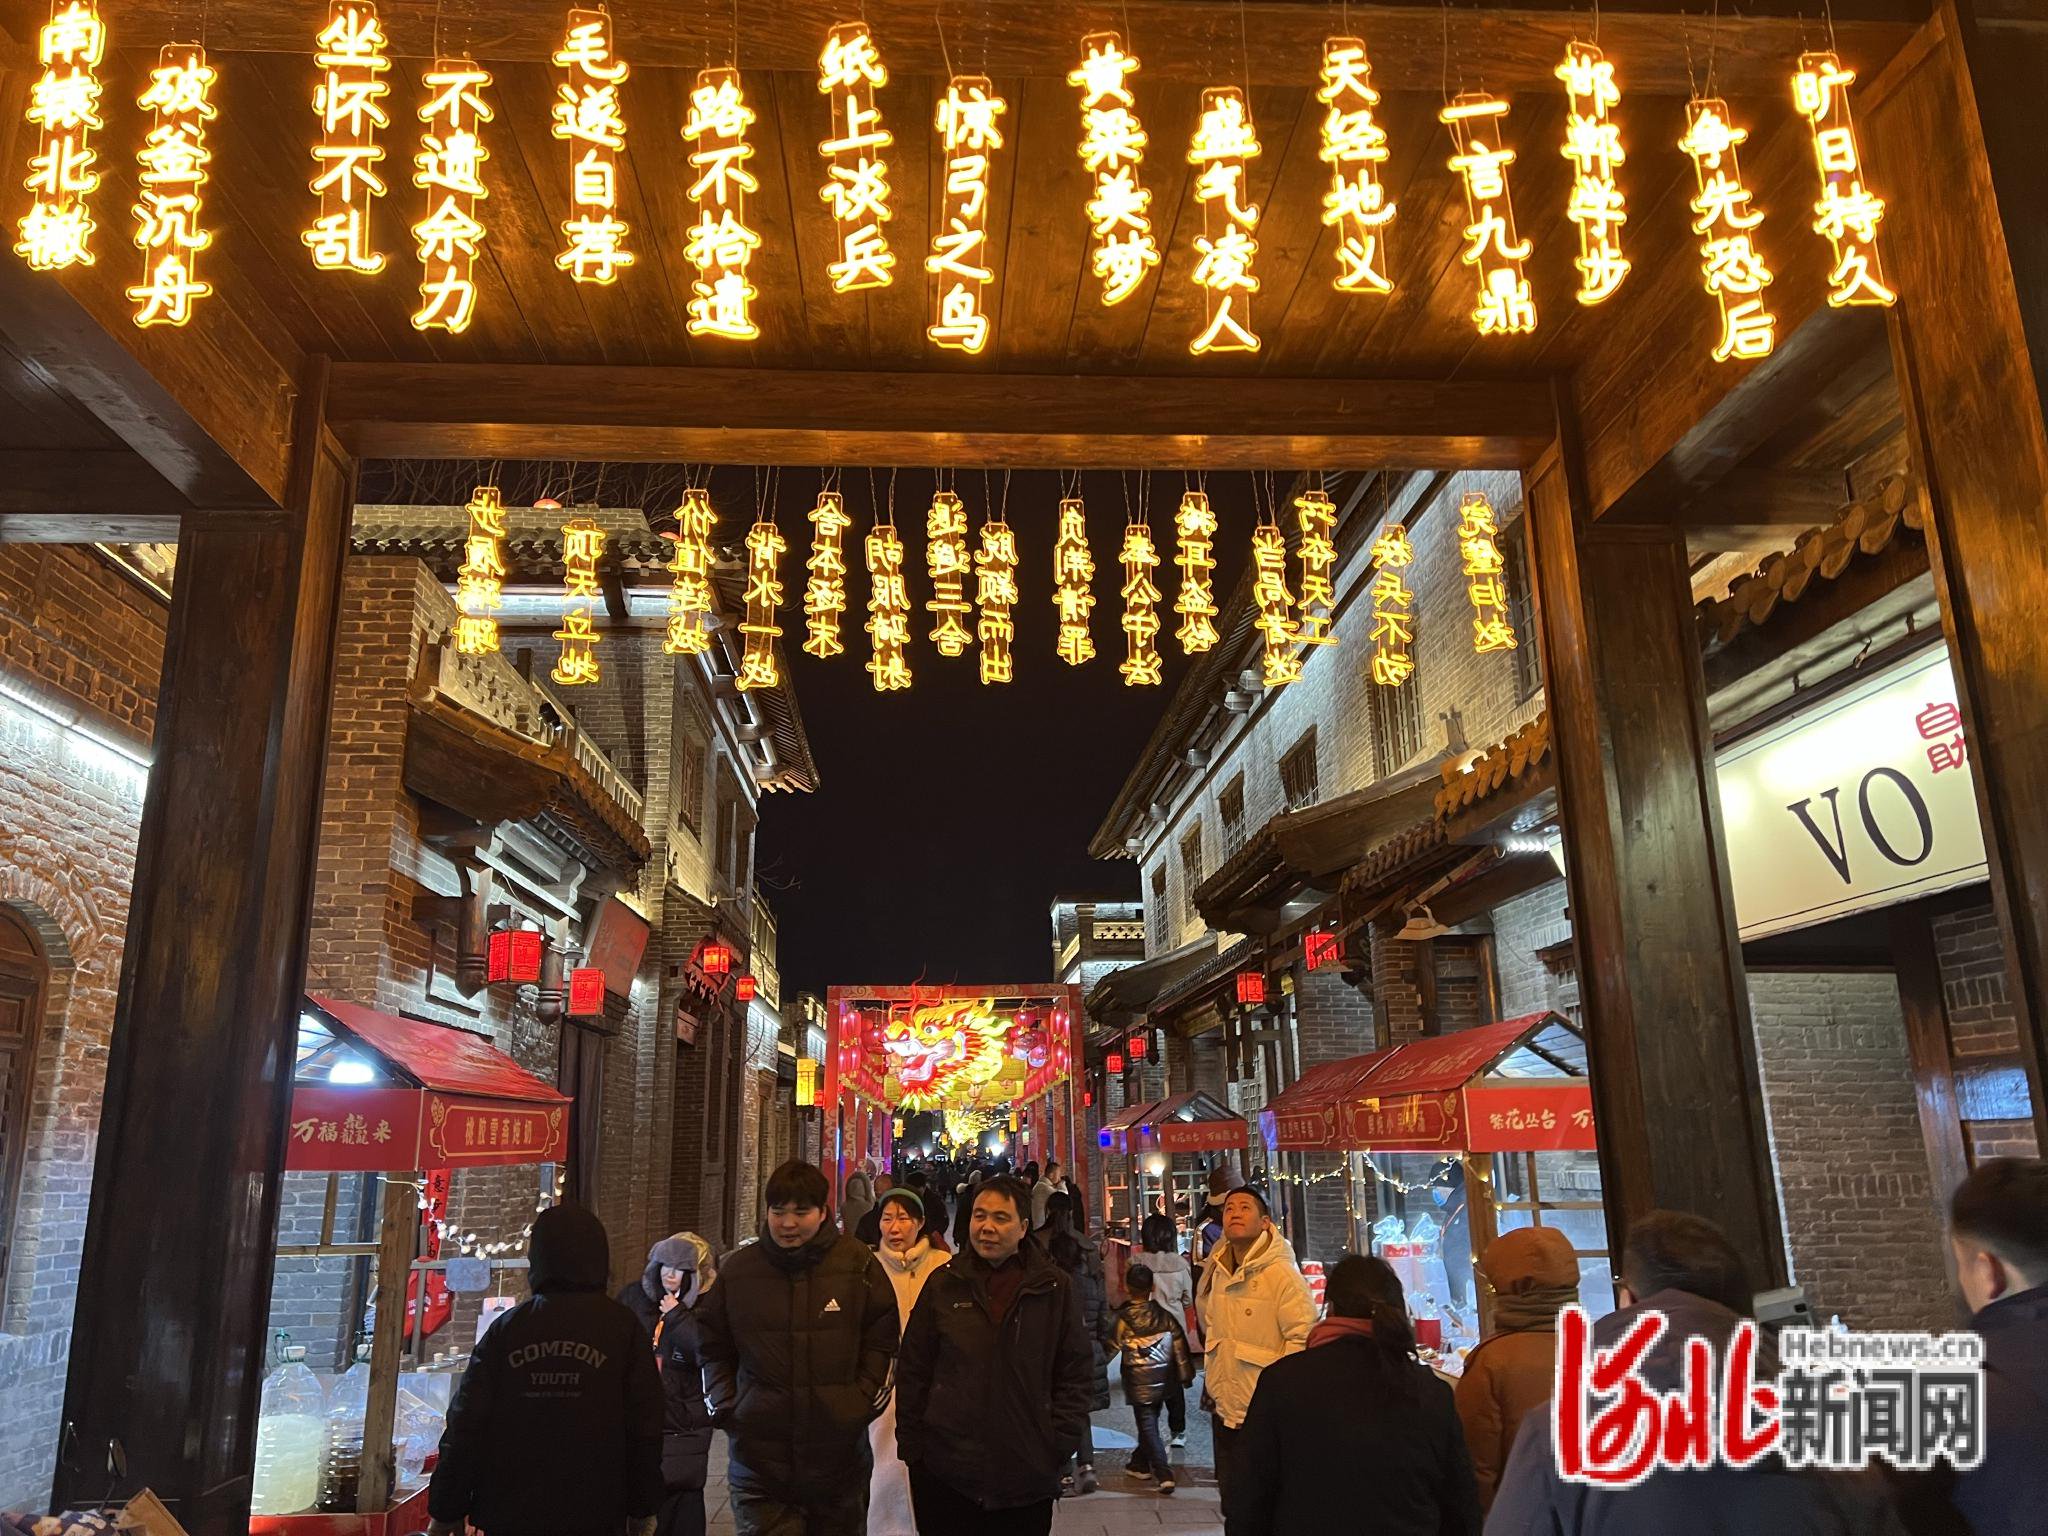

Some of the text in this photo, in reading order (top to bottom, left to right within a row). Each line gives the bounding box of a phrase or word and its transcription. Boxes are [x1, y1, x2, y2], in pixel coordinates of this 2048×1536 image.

[15, 6, 105, 269] 南辕北辙
[127, 58, 217, 326] 破釜沉舟
[302, 11, 390, 273] 坐怀不乱
[411, 70, 493, 334] 不遗余力
[552, 22, 633, 284] 毛遂自荐
[682, 79, 760, 339] 路不拾遗
[818, 33, 895, 292] 纸上谈兵
[926, 87, 1006, 353] 惊弓之鸟
[1188, 97, 1261, 353] 盛气凌人
[1317, 48, 1396, 292] 天经地义
[1440, 100, 1537, 335] 一言九鼎
[1555, 54, 1631, 306] 邯郸学步
[1678, 107, 1773, 361] 争先恐后
[1793, 62, 1896, 307] 旷日持久
[1787, 767, 1933, 884] VO
[1489, 1108, 1556, 1130] 繁花丛台
[508, 1340, 608, 1368] COMEON
[530, 1372, 580, 1386] YOUTH
